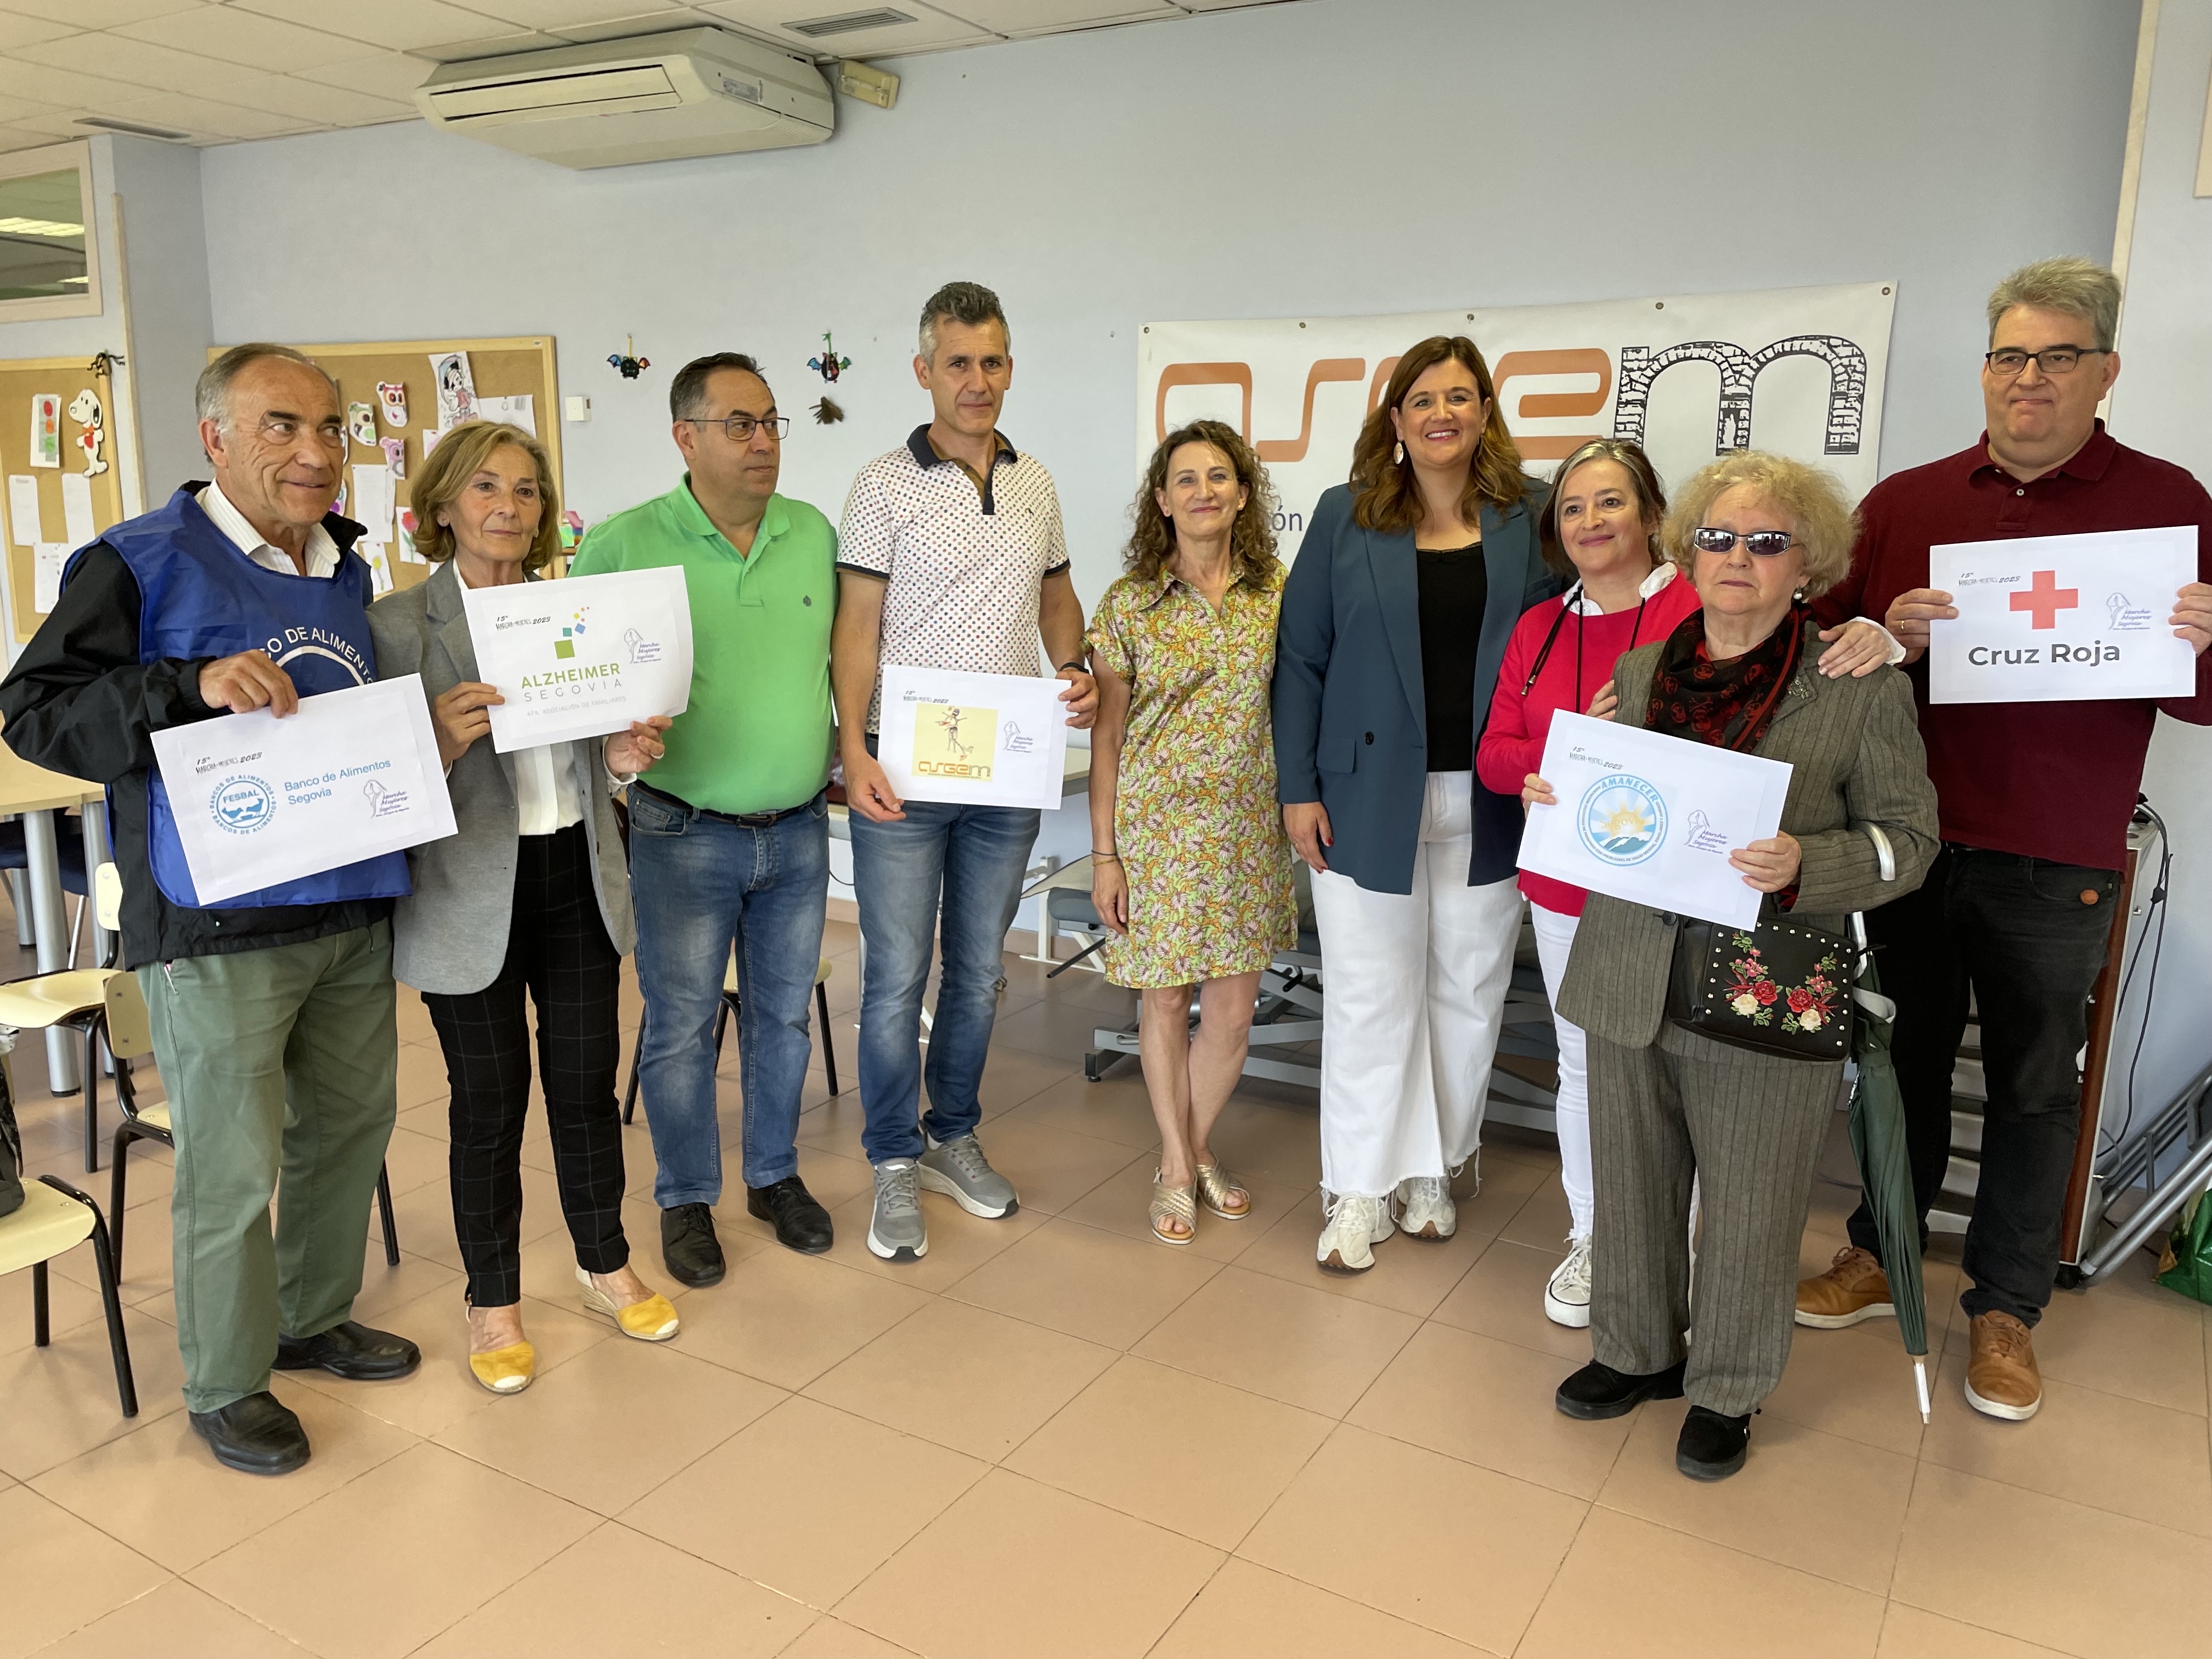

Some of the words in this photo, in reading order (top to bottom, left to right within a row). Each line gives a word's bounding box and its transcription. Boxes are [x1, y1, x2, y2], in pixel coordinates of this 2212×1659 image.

[284, 627, 308, 644] DE
[1968, 646, 2040, 666] Cruz
[2051, 640, 2120, 667] Roja
[522, 663, 620, 689] ALZHEIMER
[524, 679, 622, 702] SEGOVIA
[542, 703, 580, 714] ASOCIACIÓN
[591, 696, 627, 707] FAMILIARES
[284, 777, 319, 792] Banco
[323, 772, 336, 783] de
[340, 759, 391, 779] Alimentos
[1603, 761, 1623, 770] 2023
[210, 782, 224, 809] BANCOS
[225, 775, 235, 783] DE
[238, 774, 274, 795] ALIMENTOS
[223, 789, 259, 804] FESBAL
[288, 788, 332, 805] Segovia
[1601, 777, 1658, 803] AMANECER
